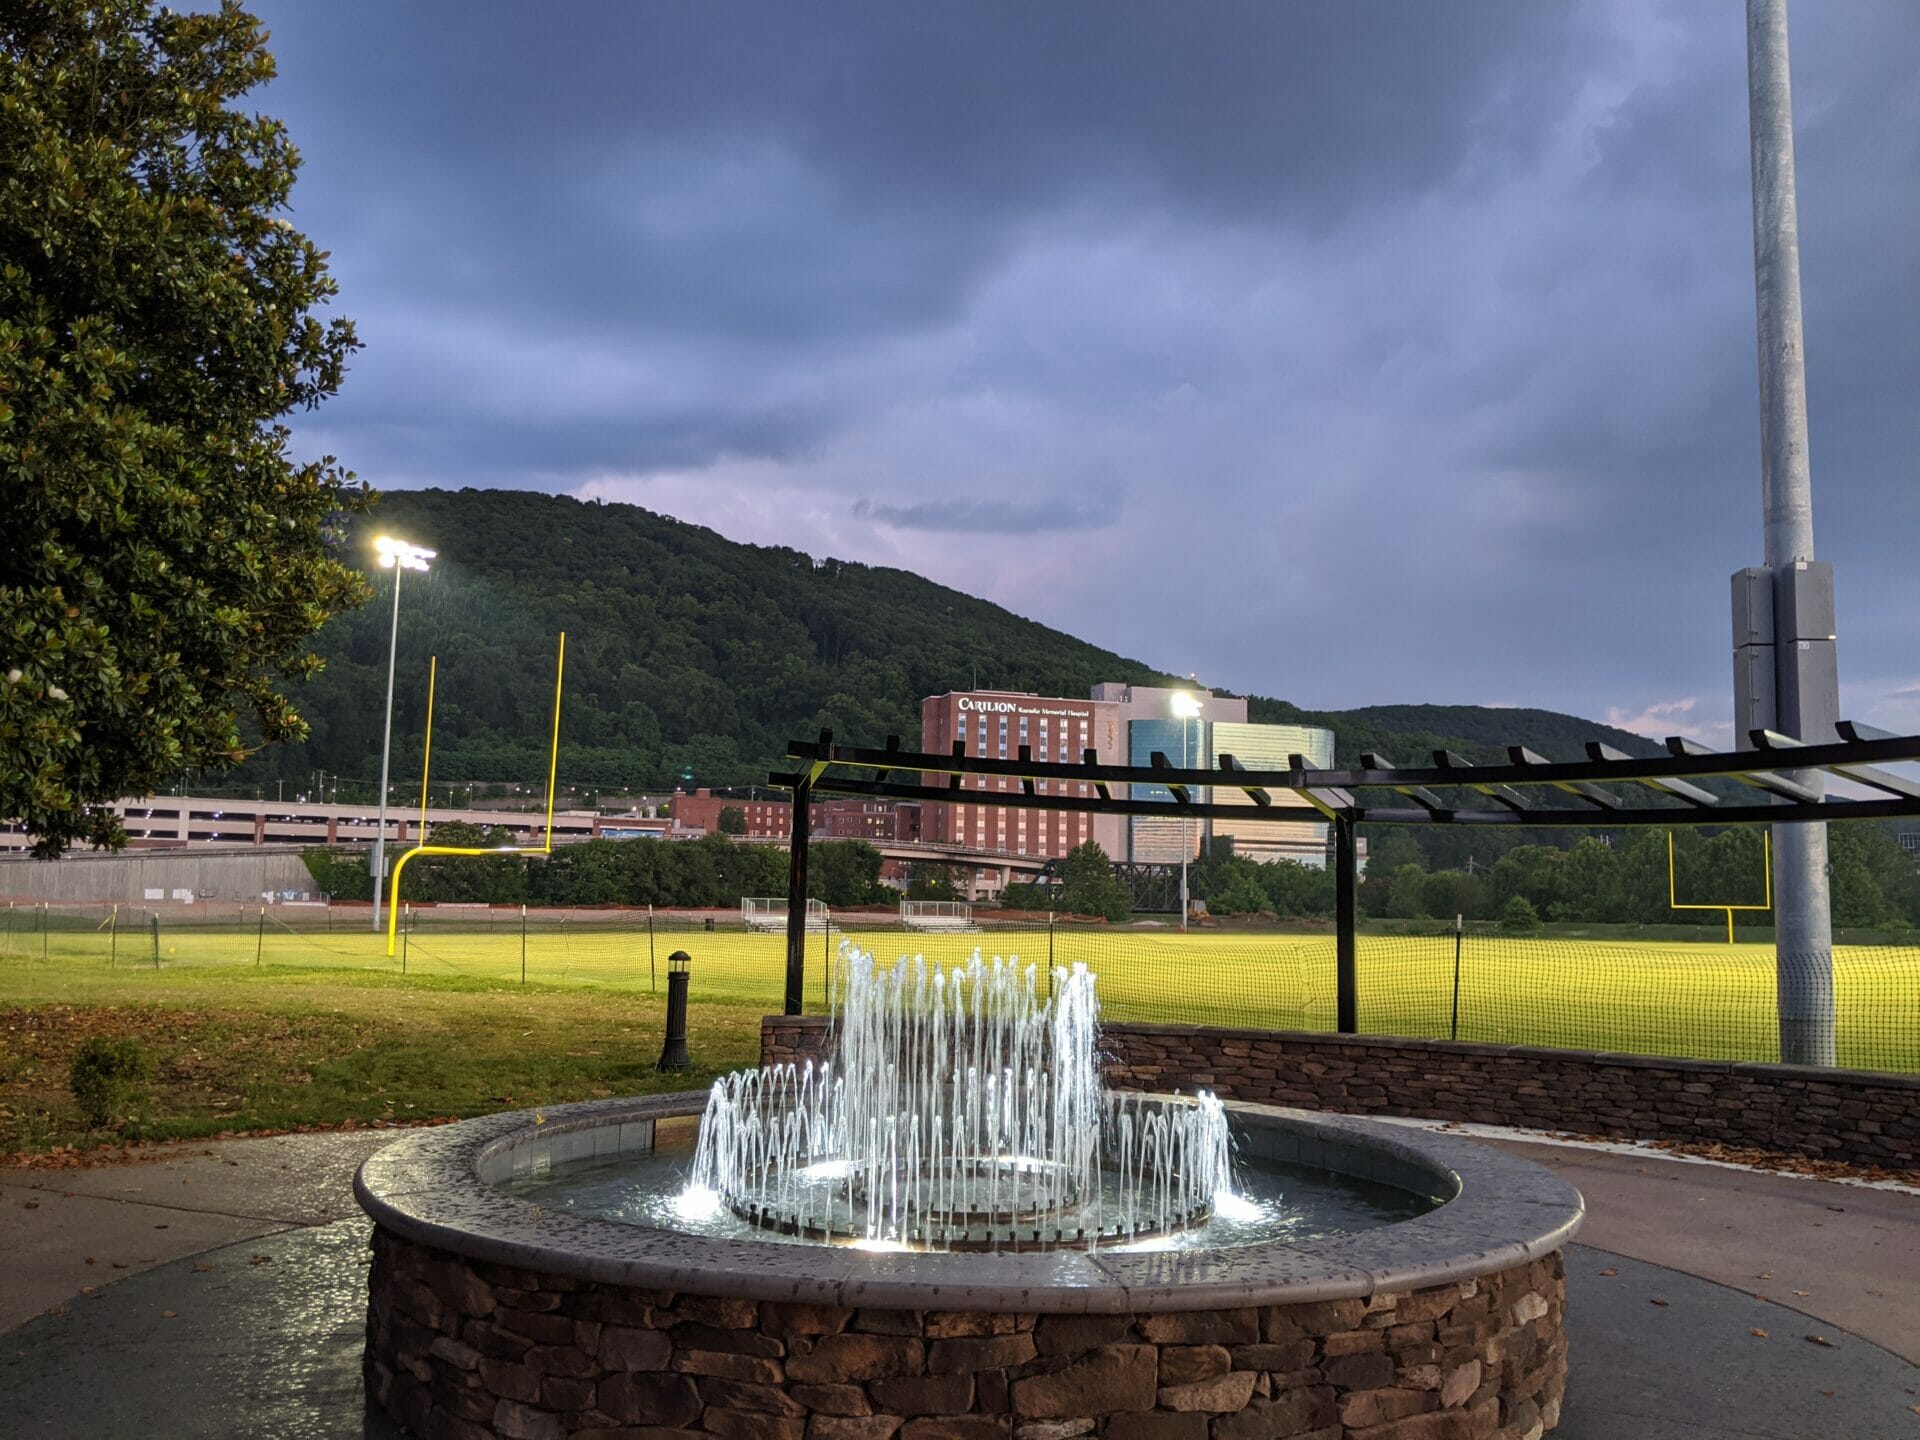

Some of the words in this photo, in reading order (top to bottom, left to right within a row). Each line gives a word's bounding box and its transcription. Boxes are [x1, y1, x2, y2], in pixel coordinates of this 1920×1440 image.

[958, 697, 1017, 713] CARILION
[1041, 708, 1066, 716] Memorial
[1067, 709, 1089, 717] Hospital
